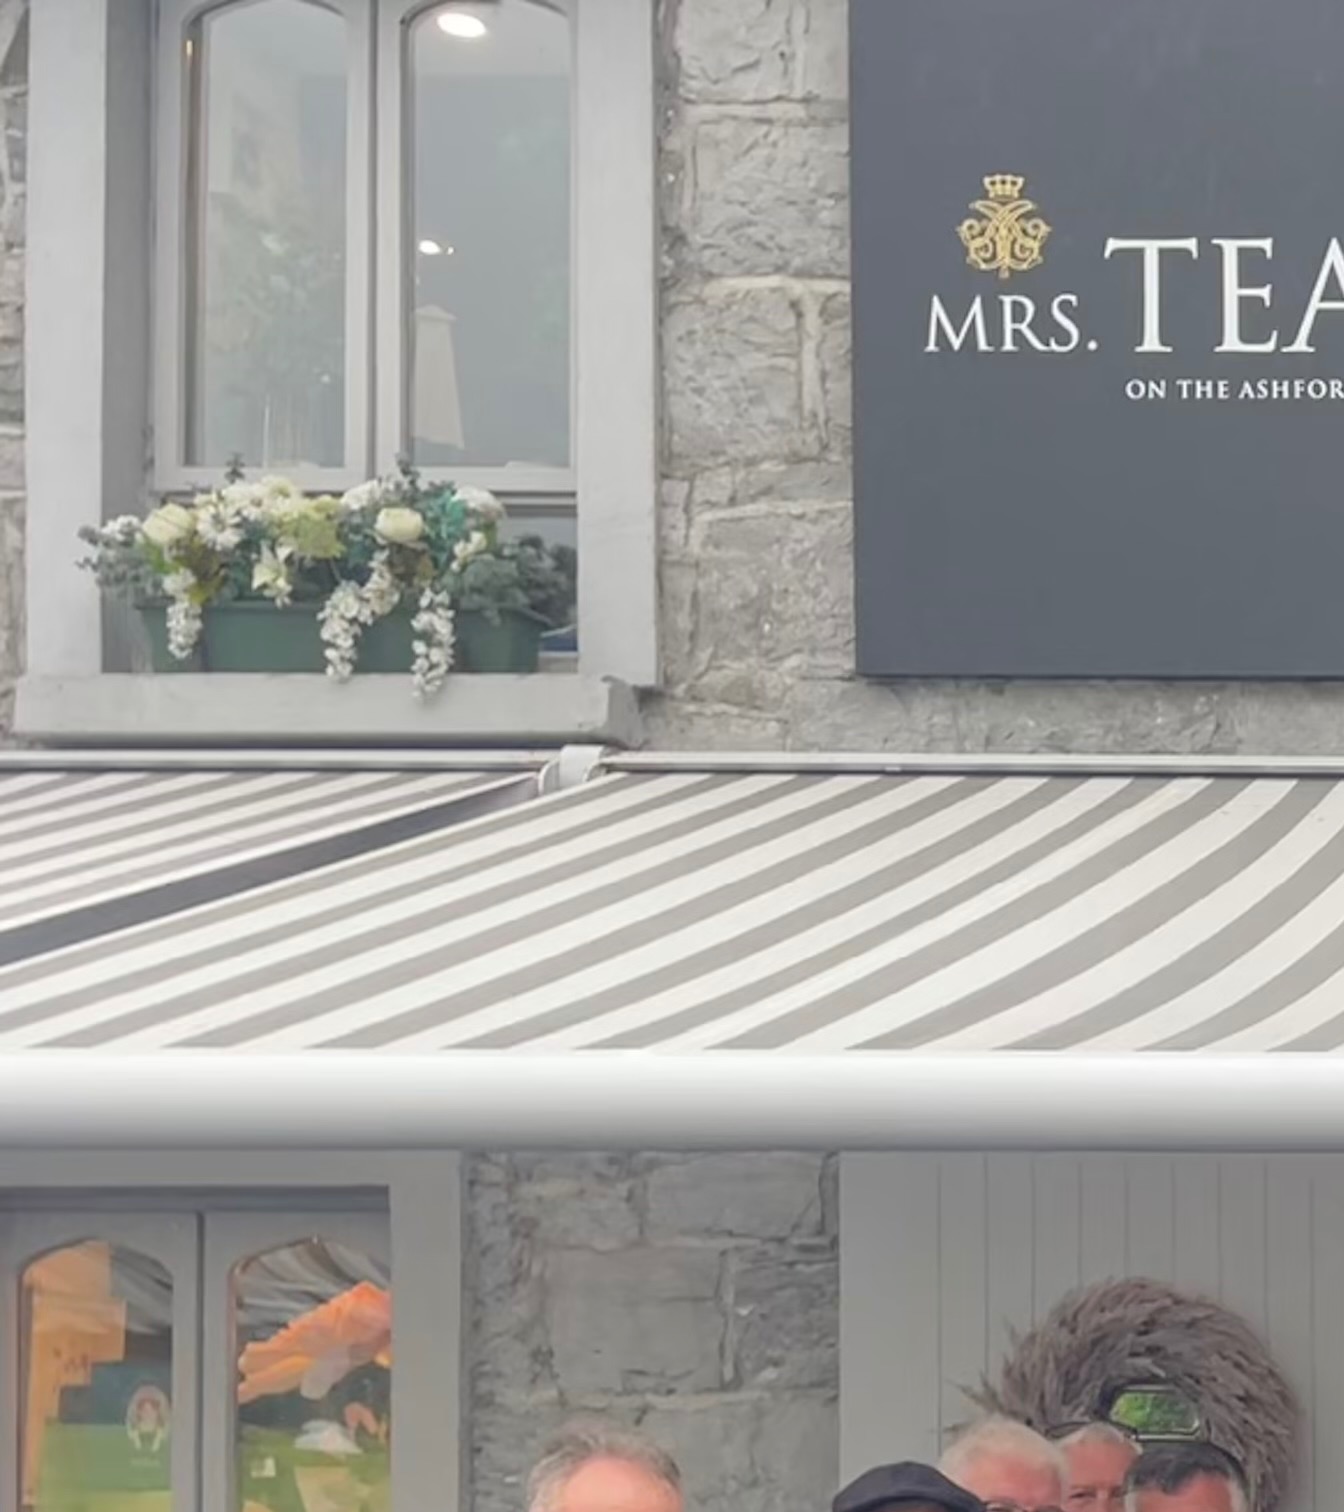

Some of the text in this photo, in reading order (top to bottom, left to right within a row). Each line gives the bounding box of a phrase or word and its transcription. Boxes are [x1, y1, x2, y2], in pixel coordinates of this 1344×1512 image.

[923, 293, 1099, 353] MRS.
[1125, 378, 1167, 399] ON
[1175, 378, 1229, 399] THE
